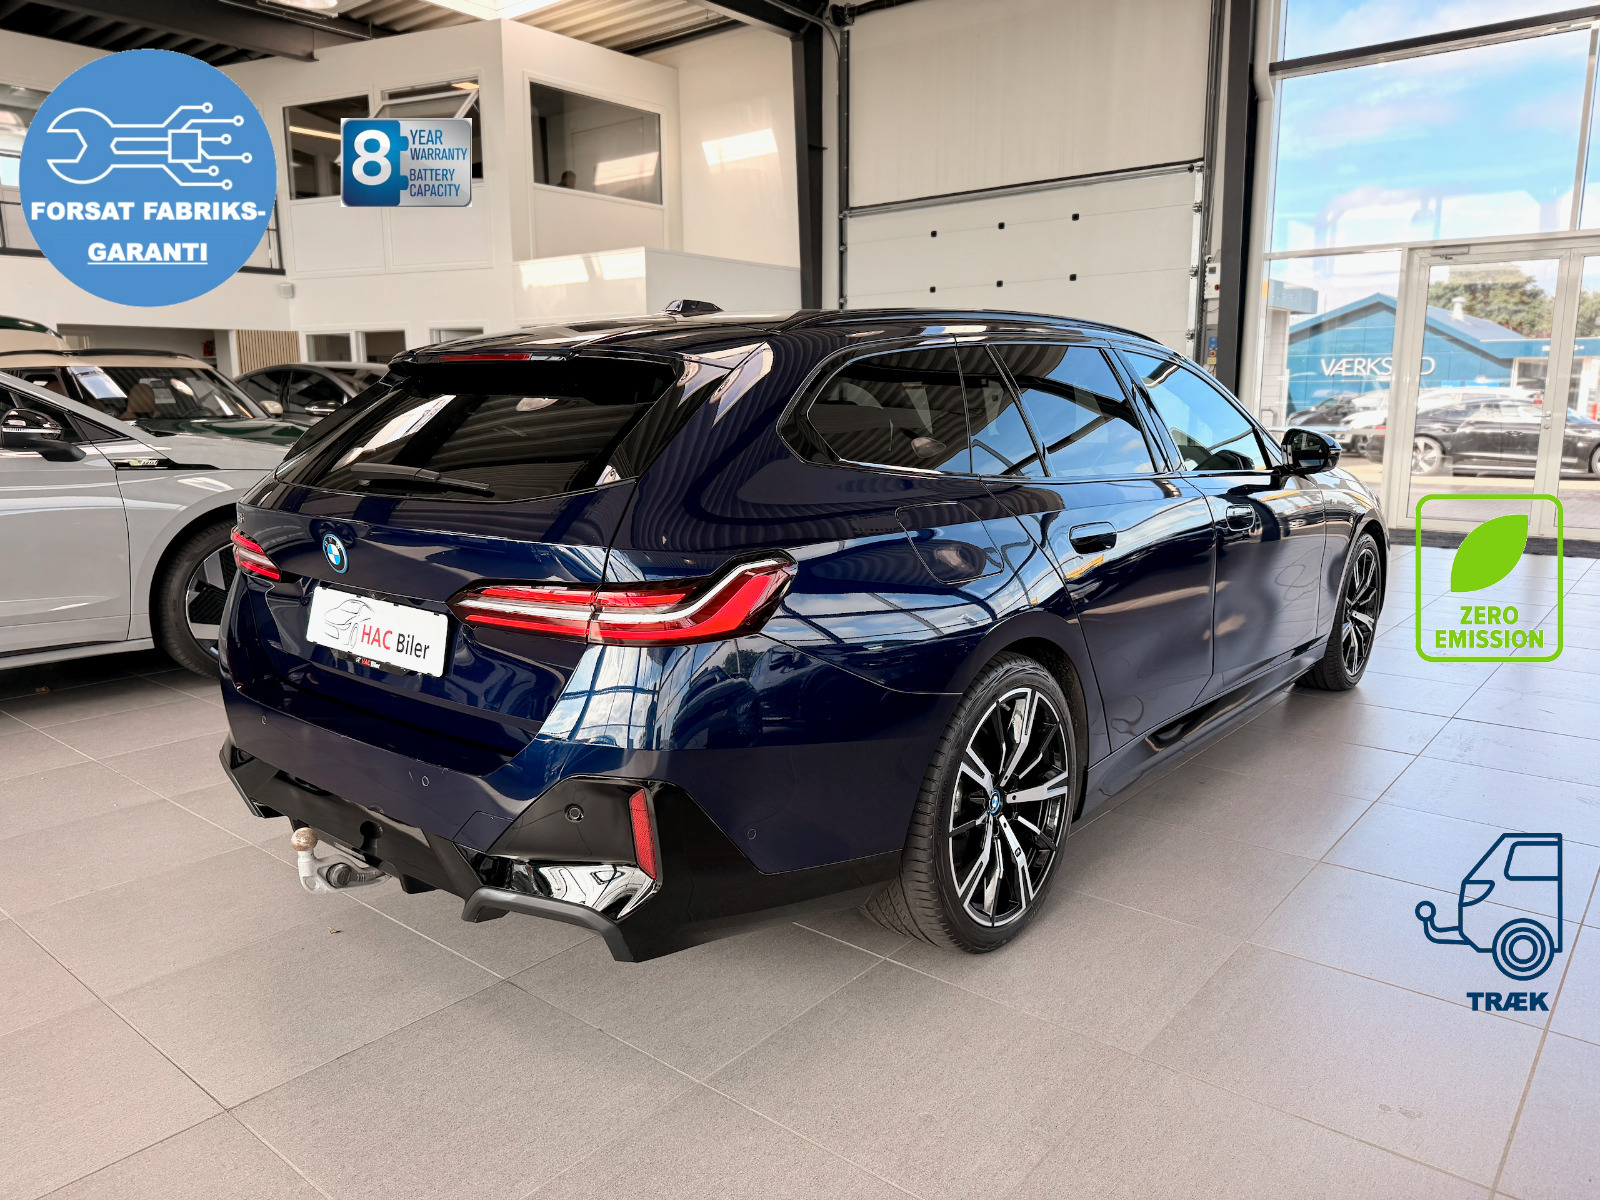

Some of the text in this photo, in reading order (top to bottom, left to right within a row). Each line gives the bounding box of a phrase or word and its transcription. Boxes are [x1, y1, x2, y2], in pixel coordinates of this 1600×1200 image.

[1320, 356, 1436, 377] VÆRKSD
[361, 624, 430, 660] HAC Biler
